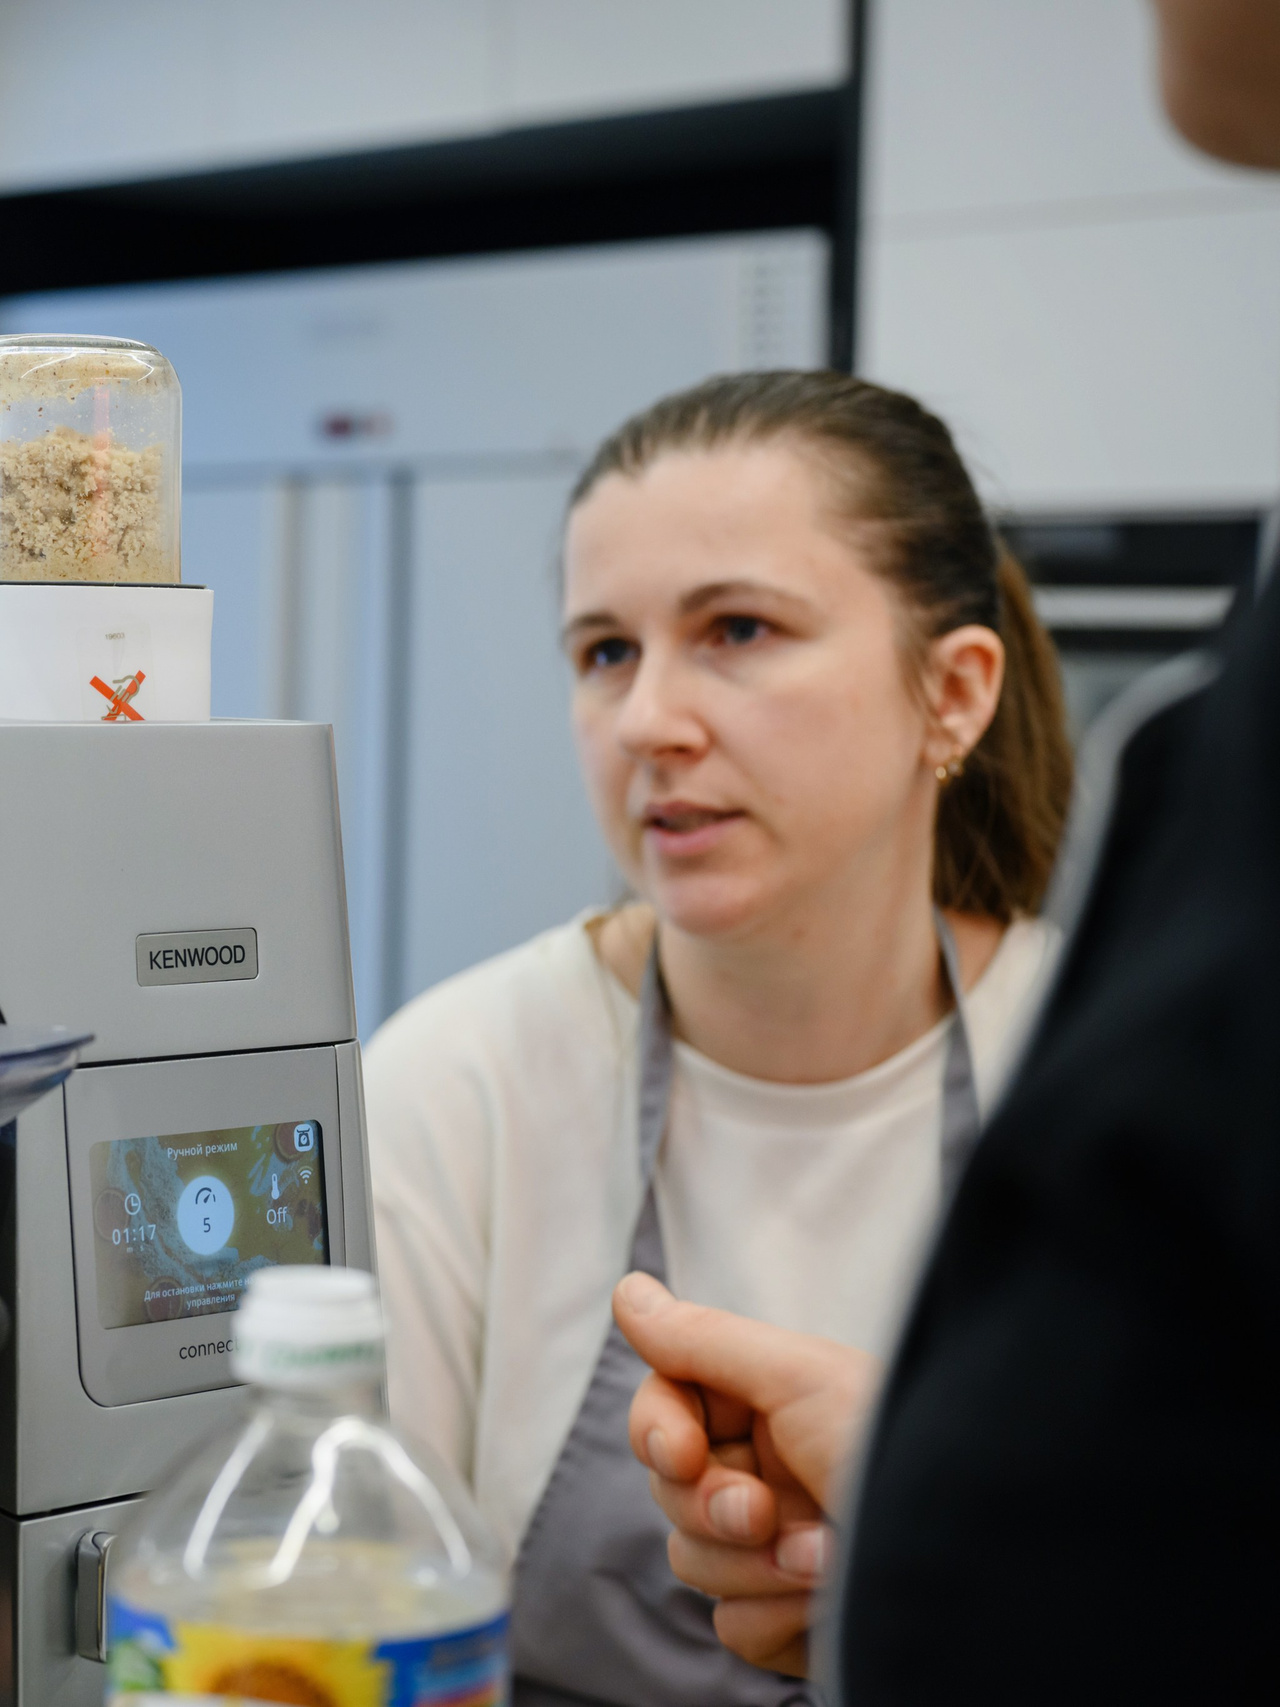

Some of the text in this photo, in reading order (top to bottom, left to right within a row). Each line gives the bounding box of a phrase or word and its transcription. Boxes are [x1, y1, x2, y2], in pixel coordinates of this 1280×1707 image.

[149, 944, 246, 970] KENWOOD
[167, 1142, 238, 1160] Ручной режим
[266, 1206, 288, 1224] Off
[203, 1217, 211, 1233] 5
[112, 1224, 157, 1246] 01:17
[144, 1290, 160, 1302] Для
[162, 1283, 206, 1298] остановки
[207, 1278, 243, 1292] нажмите
[186, 1293, 236, 1310] управления
